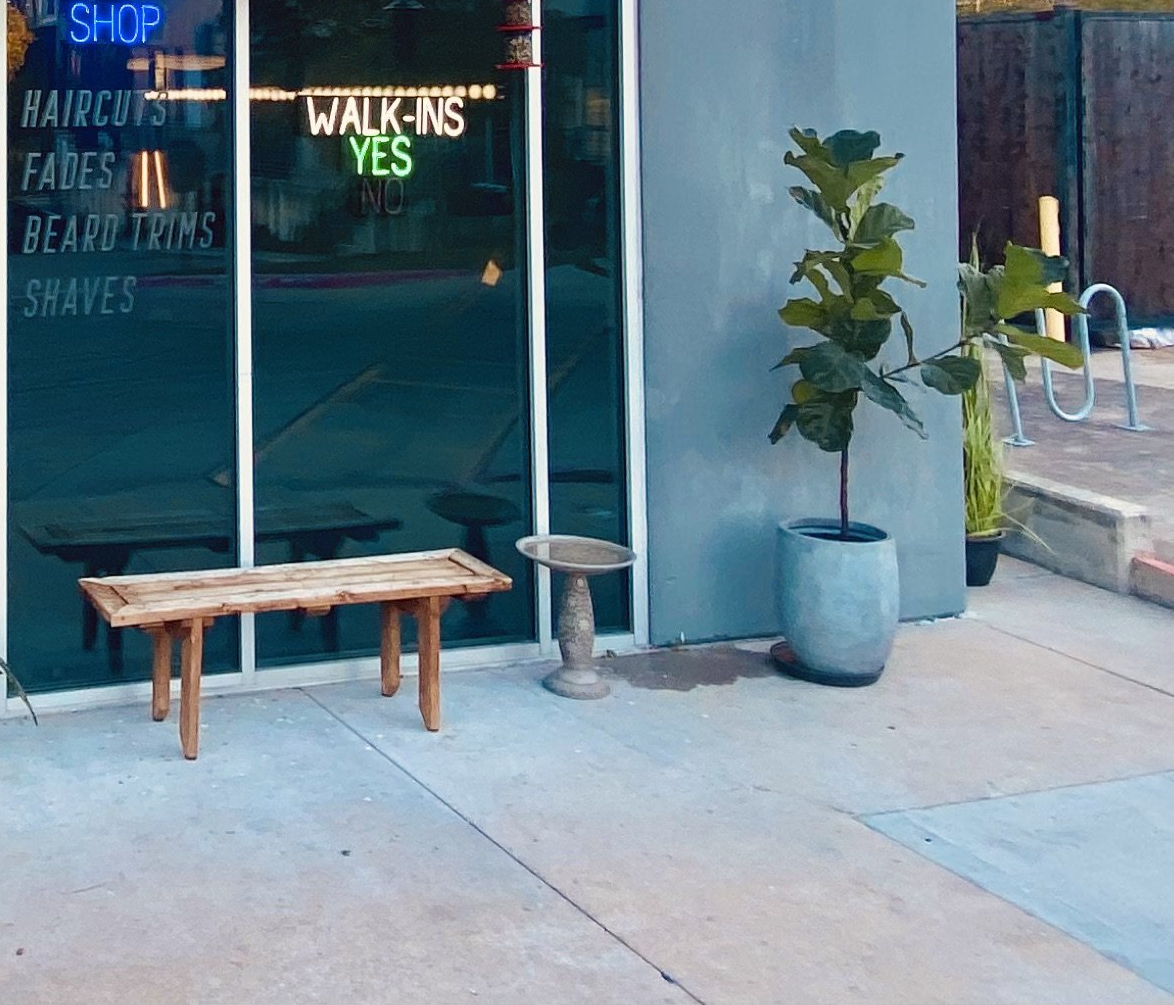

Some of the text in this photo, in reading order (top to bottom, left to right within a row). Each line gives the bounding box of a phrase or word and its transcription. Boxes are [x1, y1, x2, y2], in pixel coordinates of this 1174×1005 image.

[70, 2, 160, 44] SHOP
[20, 89, 169, 128] HAIRCUTS
[306, 96, 465, 137] WALK-INS
[21, 151, 116, 191] FADES
[349, 135, 412, 177] YES
[360, 177, 404, 215] NO
[21, 211, 217, 255] BEARD TRIMS
[23, 275, 138, 318] SHAVES
